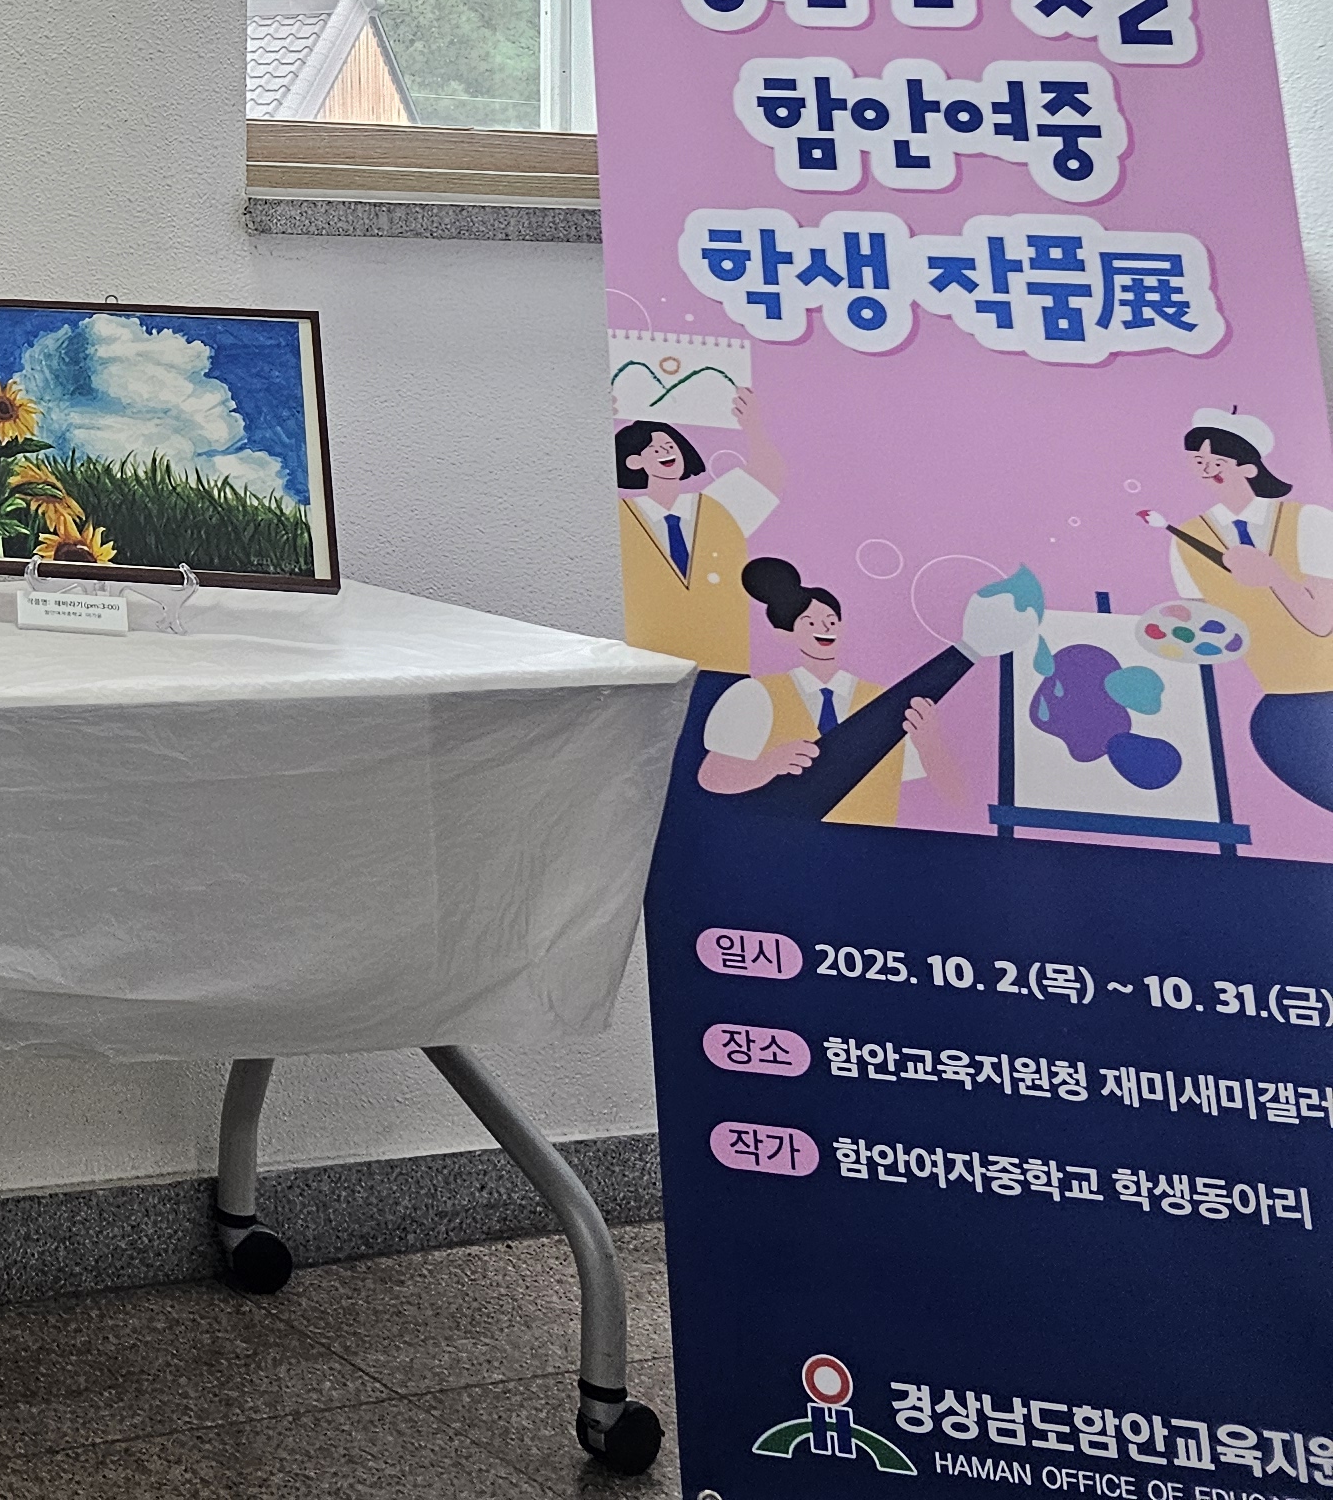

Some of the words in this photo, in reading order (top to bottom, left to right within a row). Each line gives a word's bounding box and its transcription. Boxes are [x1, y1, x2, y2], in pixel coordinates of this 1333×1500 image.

[756, 76, 1103, 182] 함안여중
[702, 228, 890, 331] 학생
[927, 234, 1199, 342] 작품展
[715, 933, 783, 974] 일시
[814, 943, 918, 984] 2025.
[926, 954, 985, 991] 10.
[993, 960, 1095, 1005] 2.(목)
[1143, 975, 1204, 1012] 10.
[720, 1028, 793, 1067] 장소
[823, 1036, 1089, 1102] 함안교육지원청
[728, 1127, 801, 1171] 작가
[832, 1137, 1104, 1202] 함안여자중학교
[1111, 1168, 1313, 1231] 학생동아리
[934, 1451, 1032, 1486] HAMAN
[1042, 1466, 1138, 1500] OFFICE
